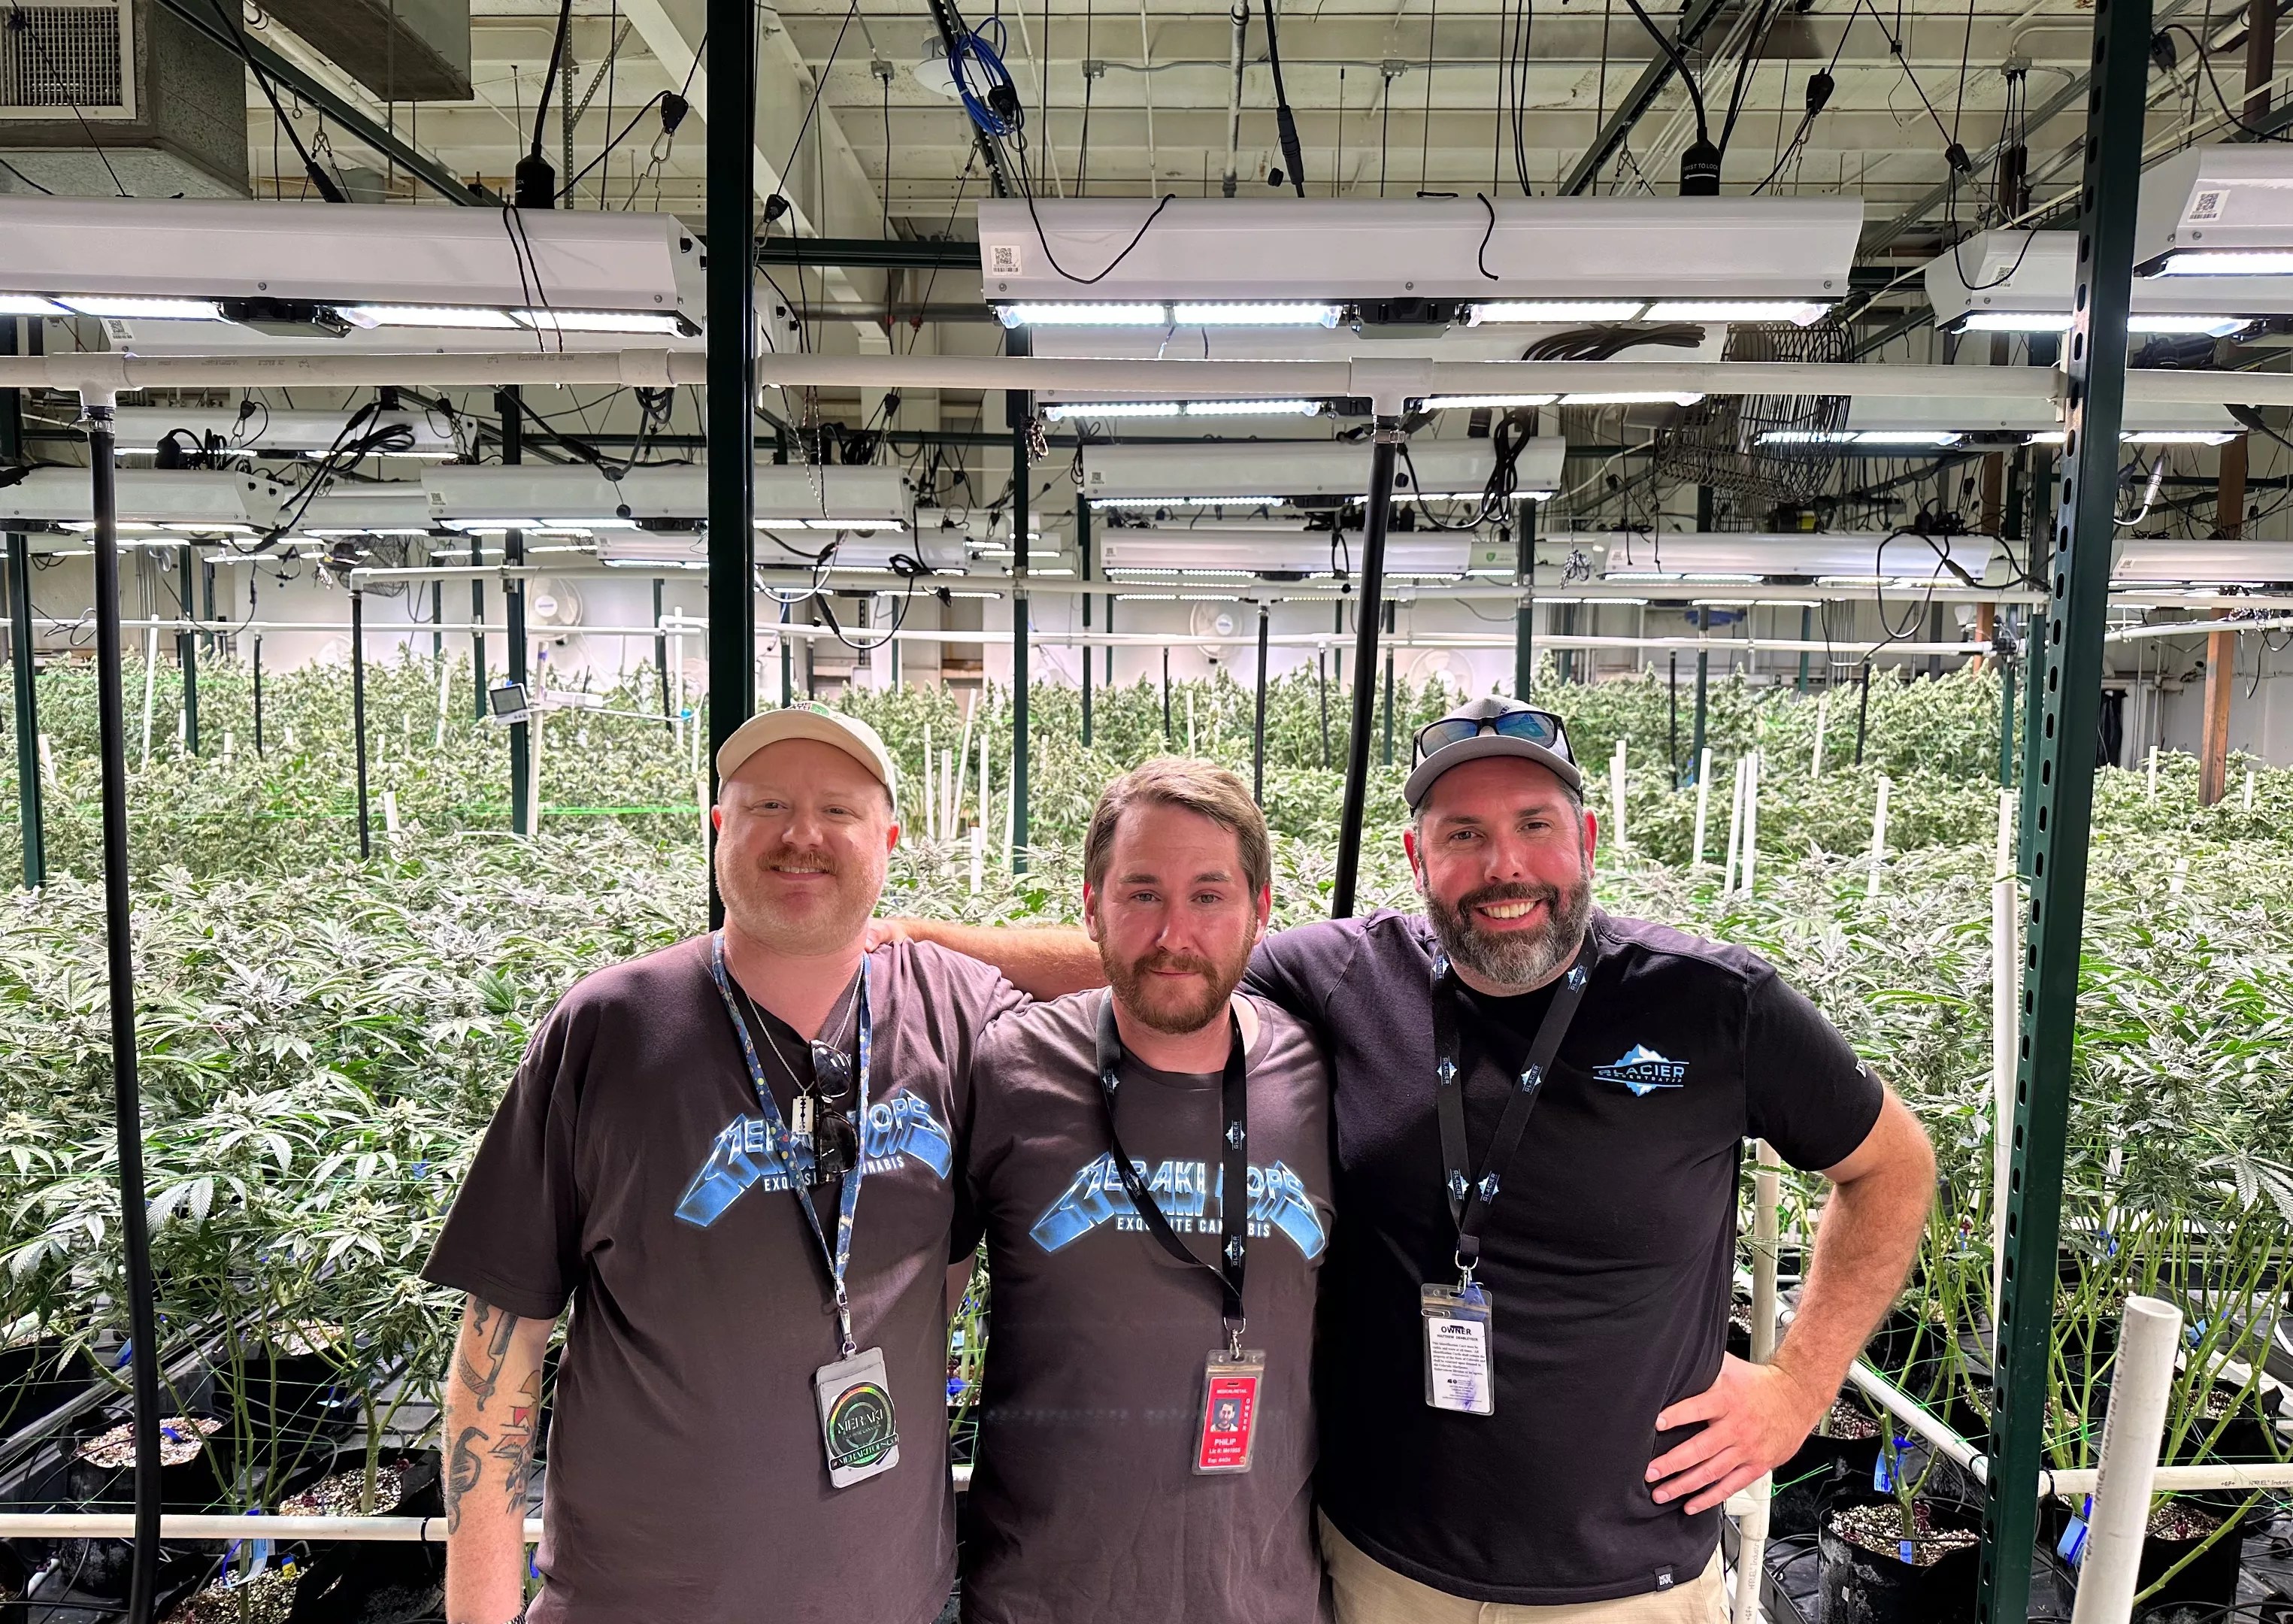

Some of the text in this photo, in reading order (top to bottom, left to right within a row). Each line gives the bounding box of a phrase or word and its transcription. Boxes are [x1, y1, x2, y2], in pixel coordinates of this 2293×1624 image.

[1524, 1065, 1539, 1092] GLACIER
[1452, 1170, 1462, 1200] GLACIER
[1483, 1173, 1496, 1202] GLACIER
[1215, 1160, 1325, 1254] OPS
[1117, 1217, 1271, 1238] EXQITE CANBIS
[1441, 1326, 1471, 1335] OWNER
[1243, 1398, 1251, 1432] OWNER
[1214, 1438, 1237, 1446] PHILIP
